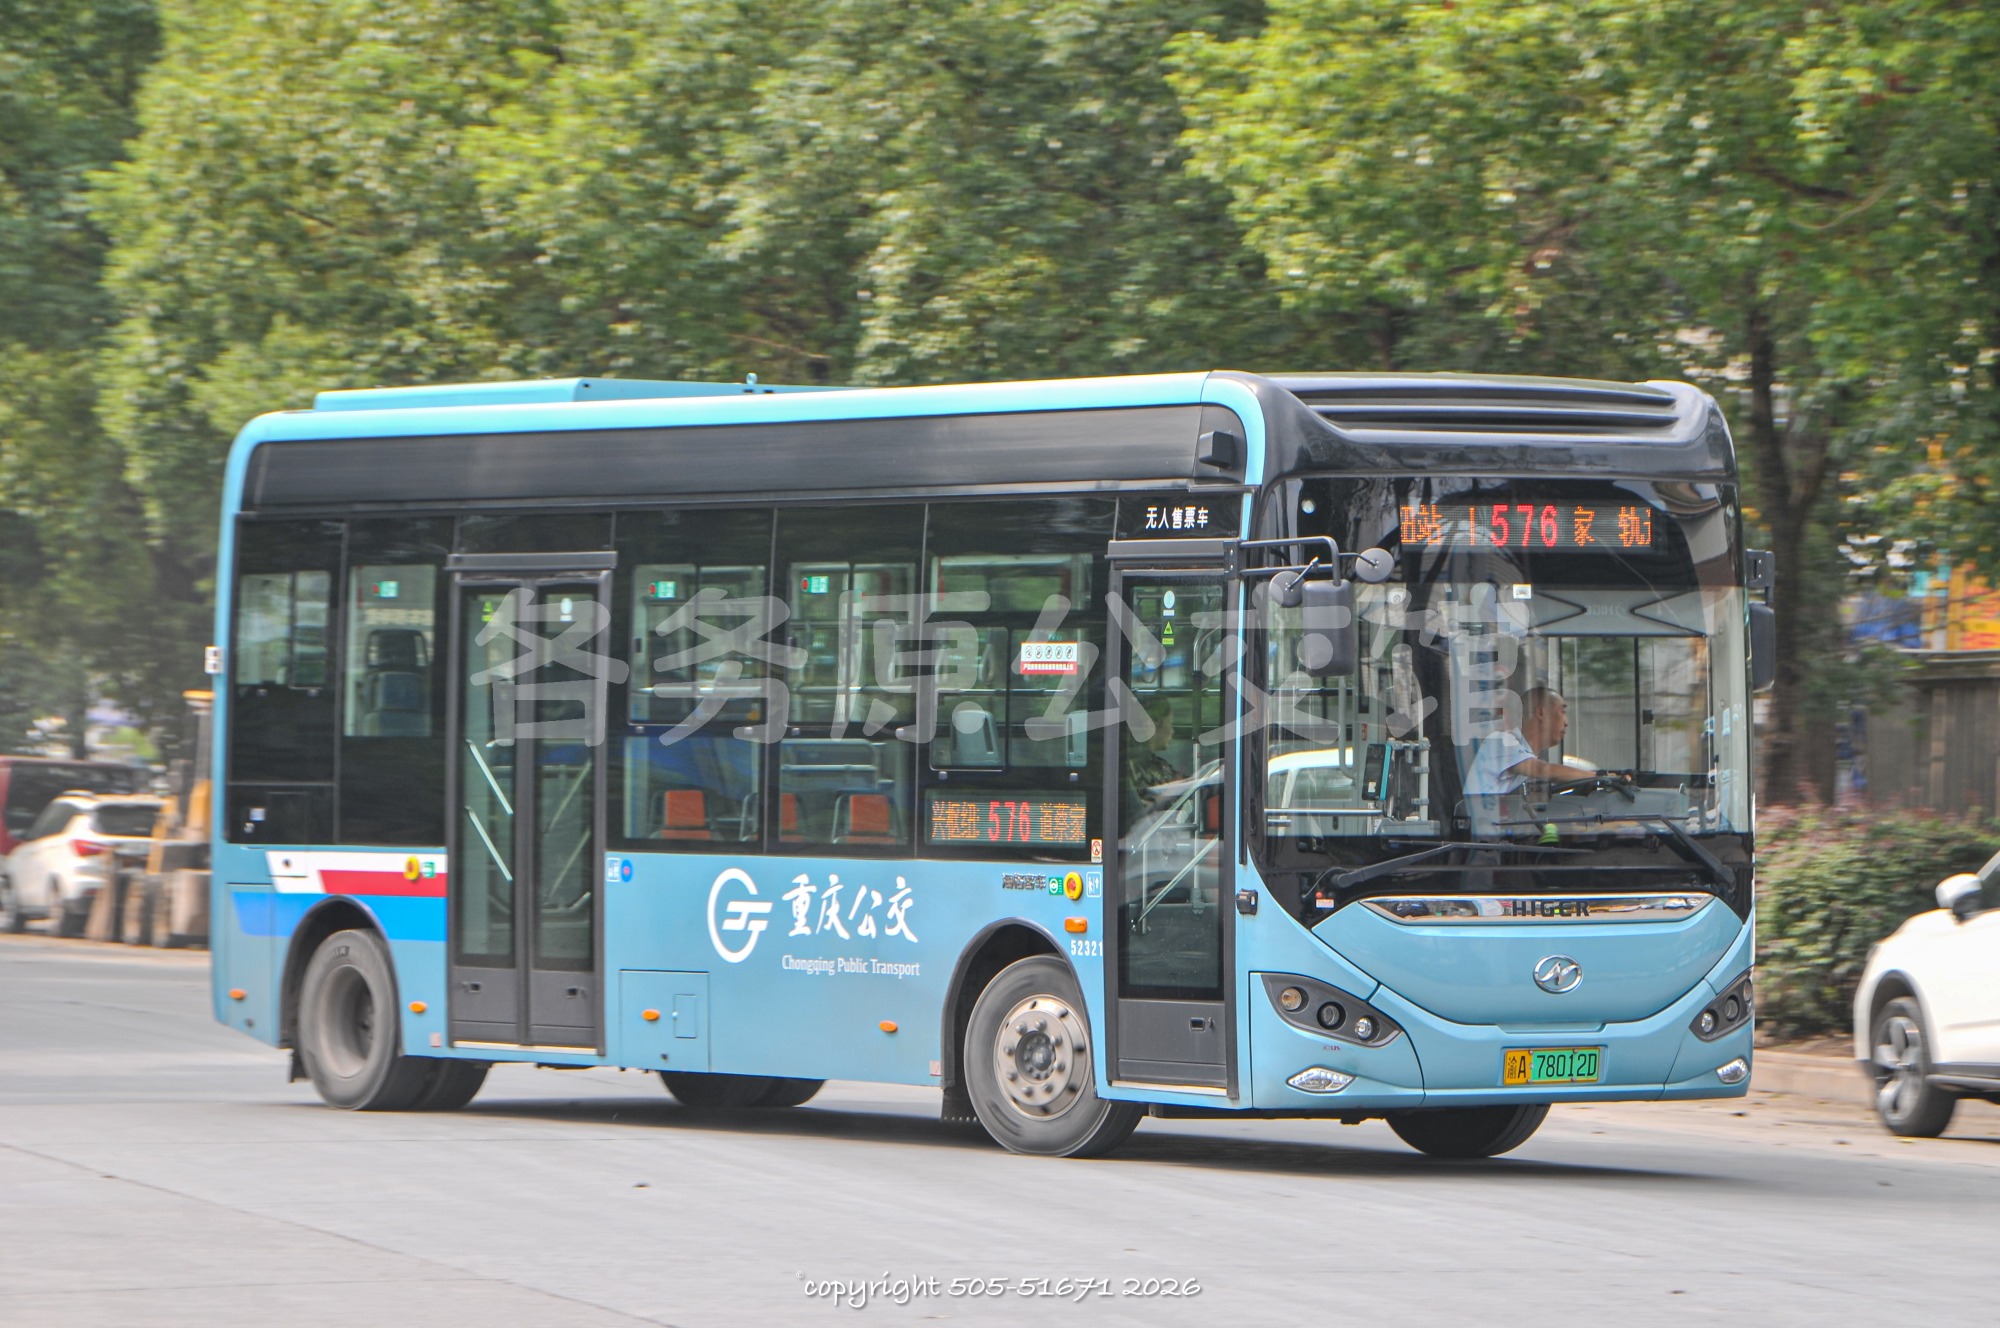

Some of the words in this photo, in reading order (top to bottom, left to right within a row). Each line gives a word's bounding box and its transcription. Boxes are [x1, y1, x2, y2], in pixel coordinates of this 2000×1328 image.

[1145, 505, 1209, 529] 无人售票车
[1490, 504, 1559, 548] 576
[988, 801, 1031, 842] 576
[781, 873, 919, 943] 重庆公交
[1512, 900, 1590, 917] HIGER
[1070, 939, 1103, 956] 52321
[781, 954, 836, 976] Chongqing
[837, 957, 869, 974] Public
[870, 959, 921, 980] Transport
